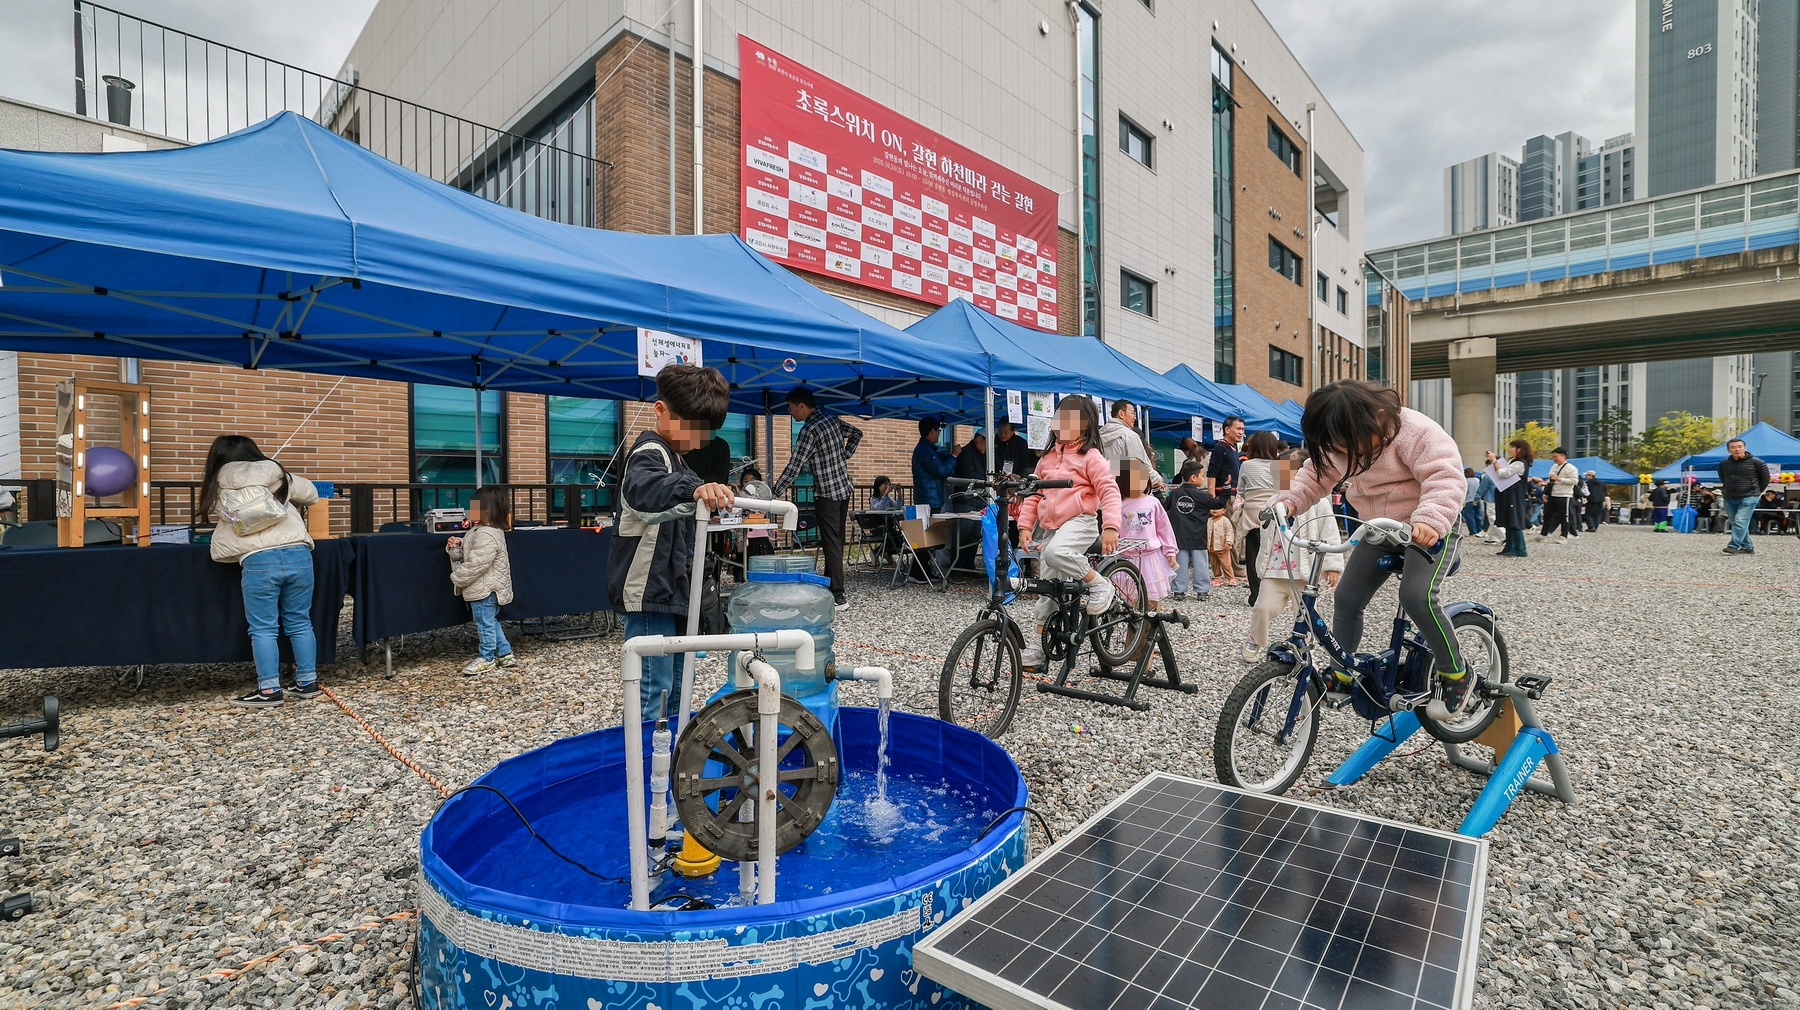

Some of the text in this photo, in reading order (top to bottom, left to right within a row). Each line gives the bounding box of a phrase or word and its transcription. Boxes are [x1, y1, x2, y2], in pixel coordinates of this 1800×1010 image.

[1687, 43, 1712, 59] 803
[796, 88, 1034, 215] 초록스위치 ON, 갈현 하천따라 걷는 갈현
[754, 158, 784, 173] VIVAFRESH
[652, 338, 691, 350] 신재생에너지로
[653, 350, 671, 358] 놀자~
[1503, 756, 1535, 801] TRAINER
